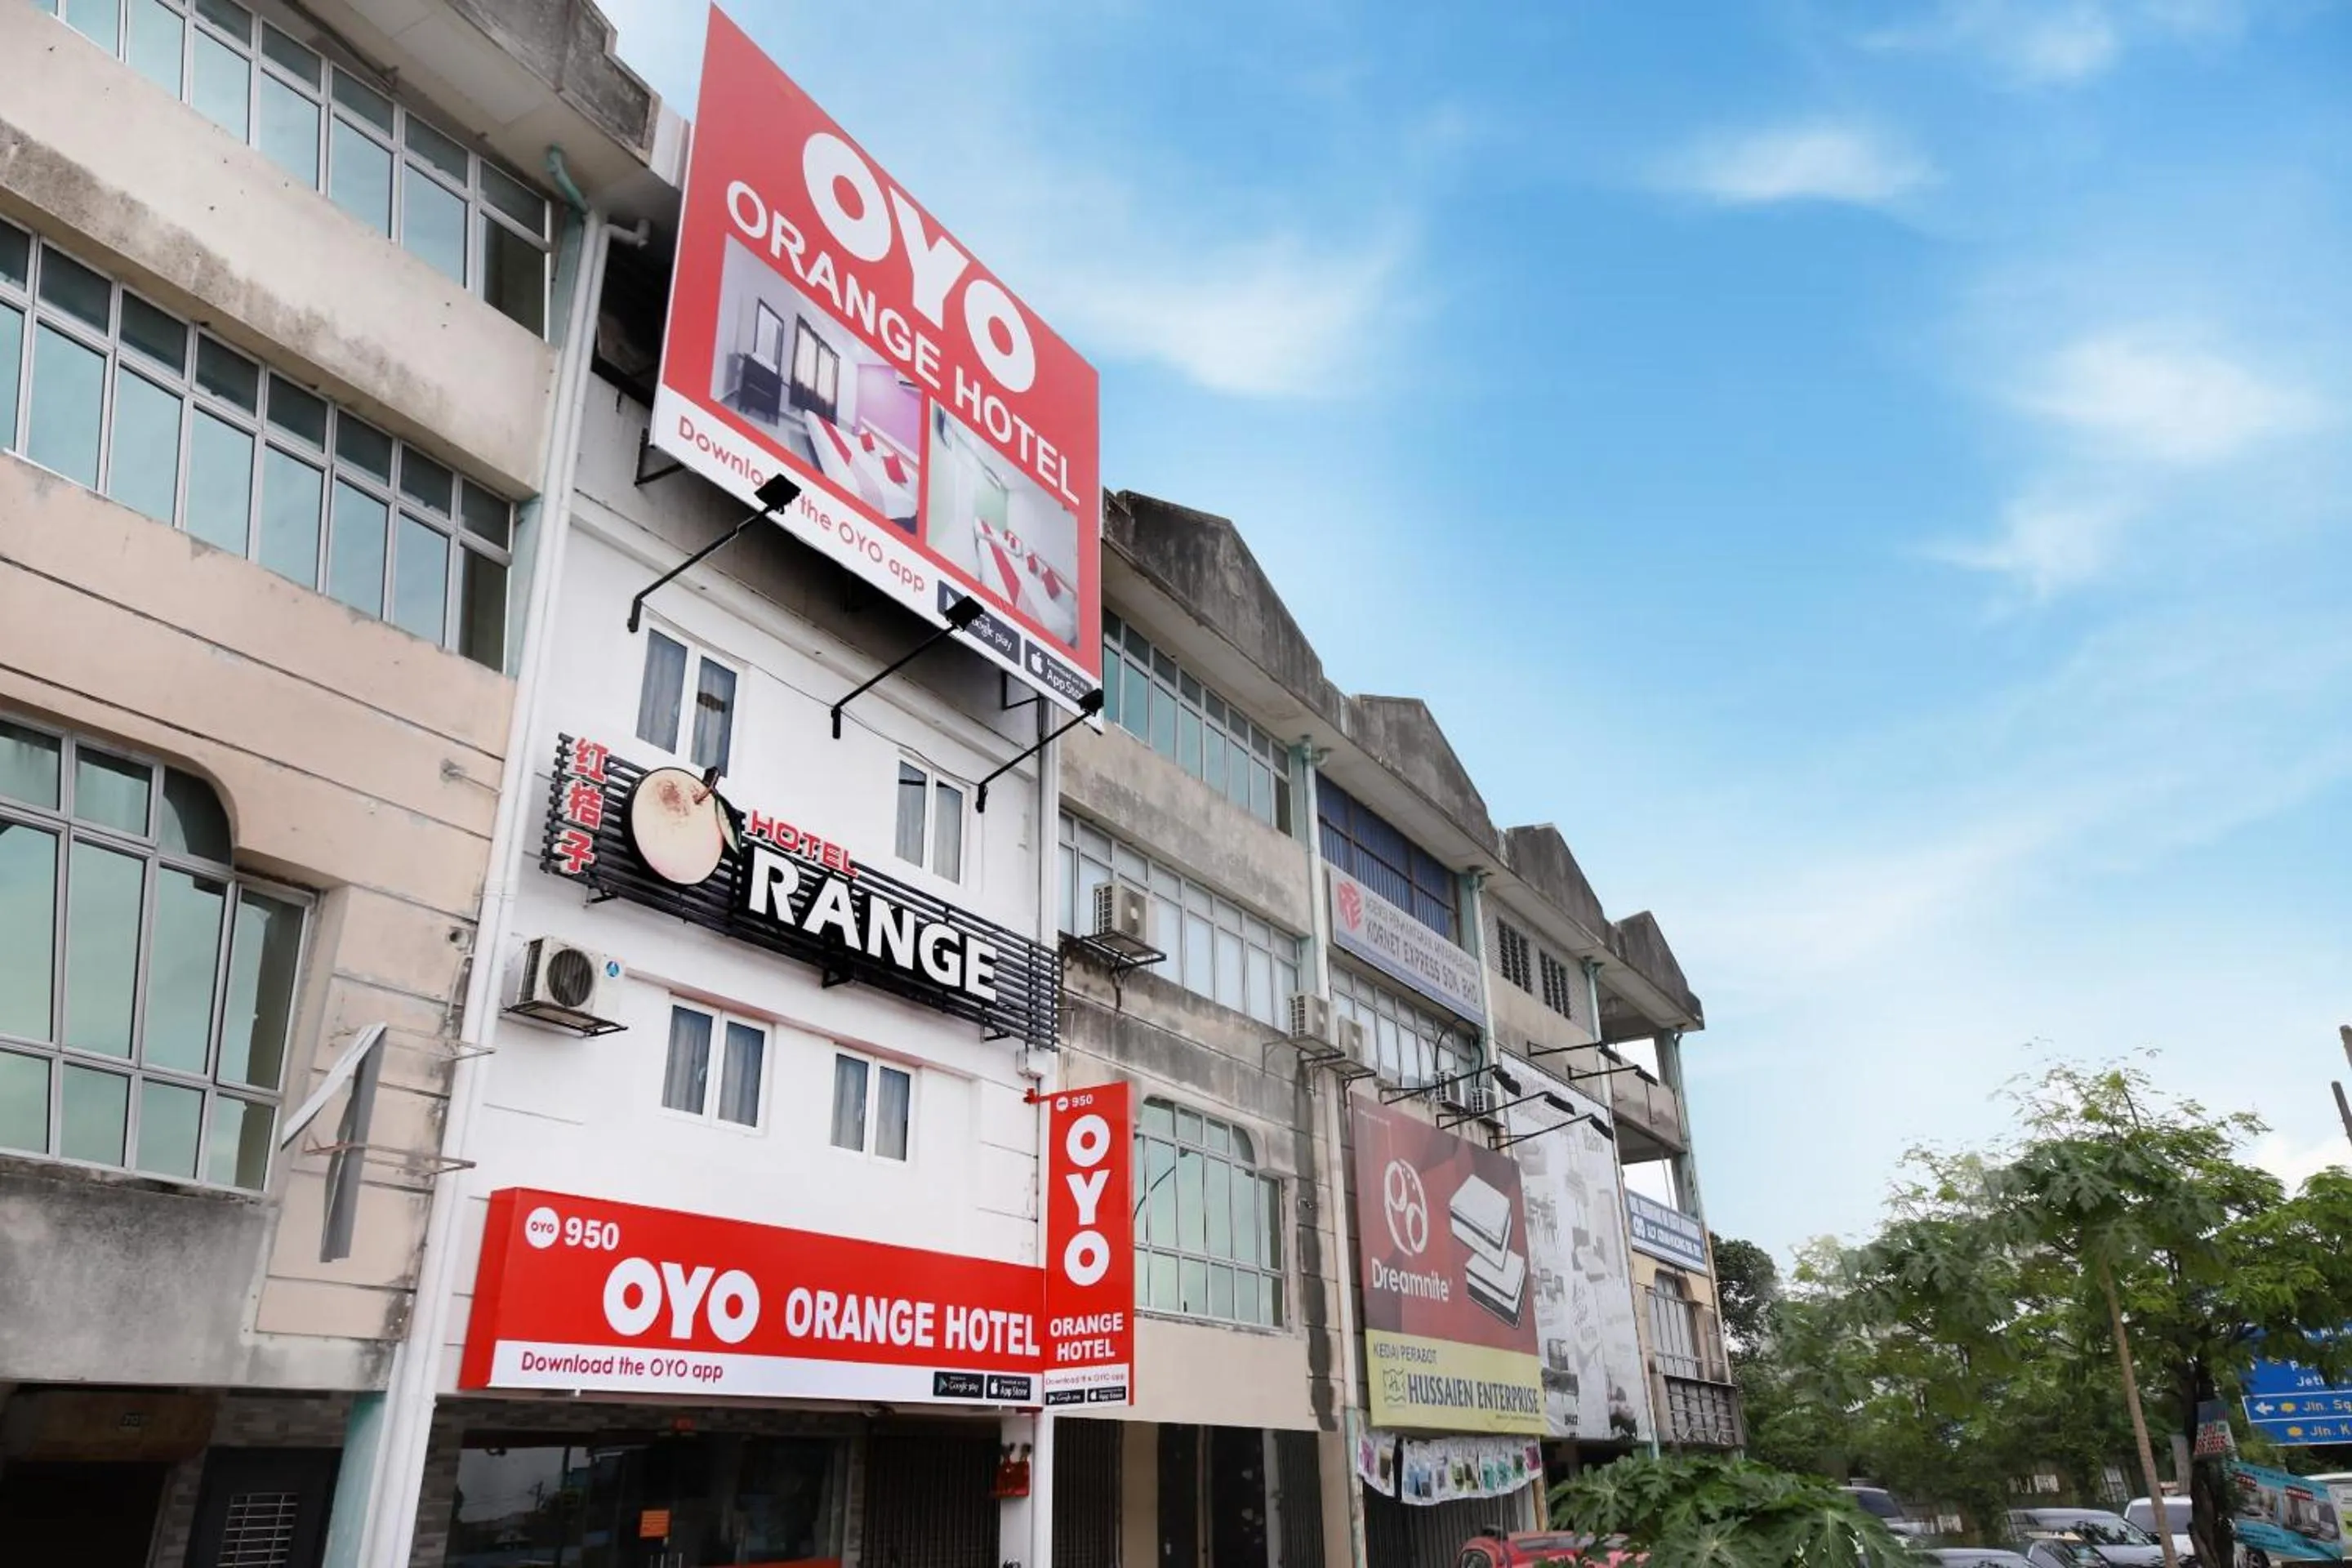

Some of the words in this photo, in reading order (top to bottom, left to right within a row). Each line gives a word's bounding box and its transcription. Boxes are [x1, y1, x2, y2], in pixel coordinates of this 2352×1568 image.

[802, 132, 1036, 394] OYO
[726, 180, 942, 391] ORANGE
[954, 363, 1080, 506] HOTEL
[679, 415, 793, 508] Downlo
[800, 495, 832, 531] the
[838, 521, 883, 563] OYO
[889, 559, 924, 593] app
[995, 633, 1013, 652] play
[1046, 669, 1065, 690] App
[1065, 680, 1084, 700] Stor
[746, 810, 859, 879] HOTEL
[748, 846, 999, 1004] RANGE
[1403, 941, 1441, 982] EXPRESS
[1071, 1094, 1094, 1107] 950
[1063, 1114, 1111, 1287] OYO
[530, 1220, 555, 1234] OYO
[564, 1217, 620, 1251] 950
[603, 1256, 760, 1344] OYO
[1371, 1257, 1450, 1303] Dreamnite
[785, 1286, 936, 1349] ORANGE
[944, 1303, 1040, 1358] HOTEL
[1049, 1312, 1124, 1338] ORANGE
[521, 1351, 613, 1374] Download
[618, 1356, 644, 1375] the
[650, 1357, 688, 1378] OYO
[693, 1364, 724, 1383] app
[1056, 1338, 1116, 1362] HOTEL
[1373, 1342, 1400, 1360] KEDAI
[1401, 1346, 1437, 1364] PERABOT
[948, 1380, 967, 1393] Google
[1000, 1386, 1013, 1397] App
[1013, 1386, 1027, 1396] Store
[1407, 1373, 1474, 1408] HUSSAIEN
[1477, 1380, 1540, 1414] ENTERPRISE
